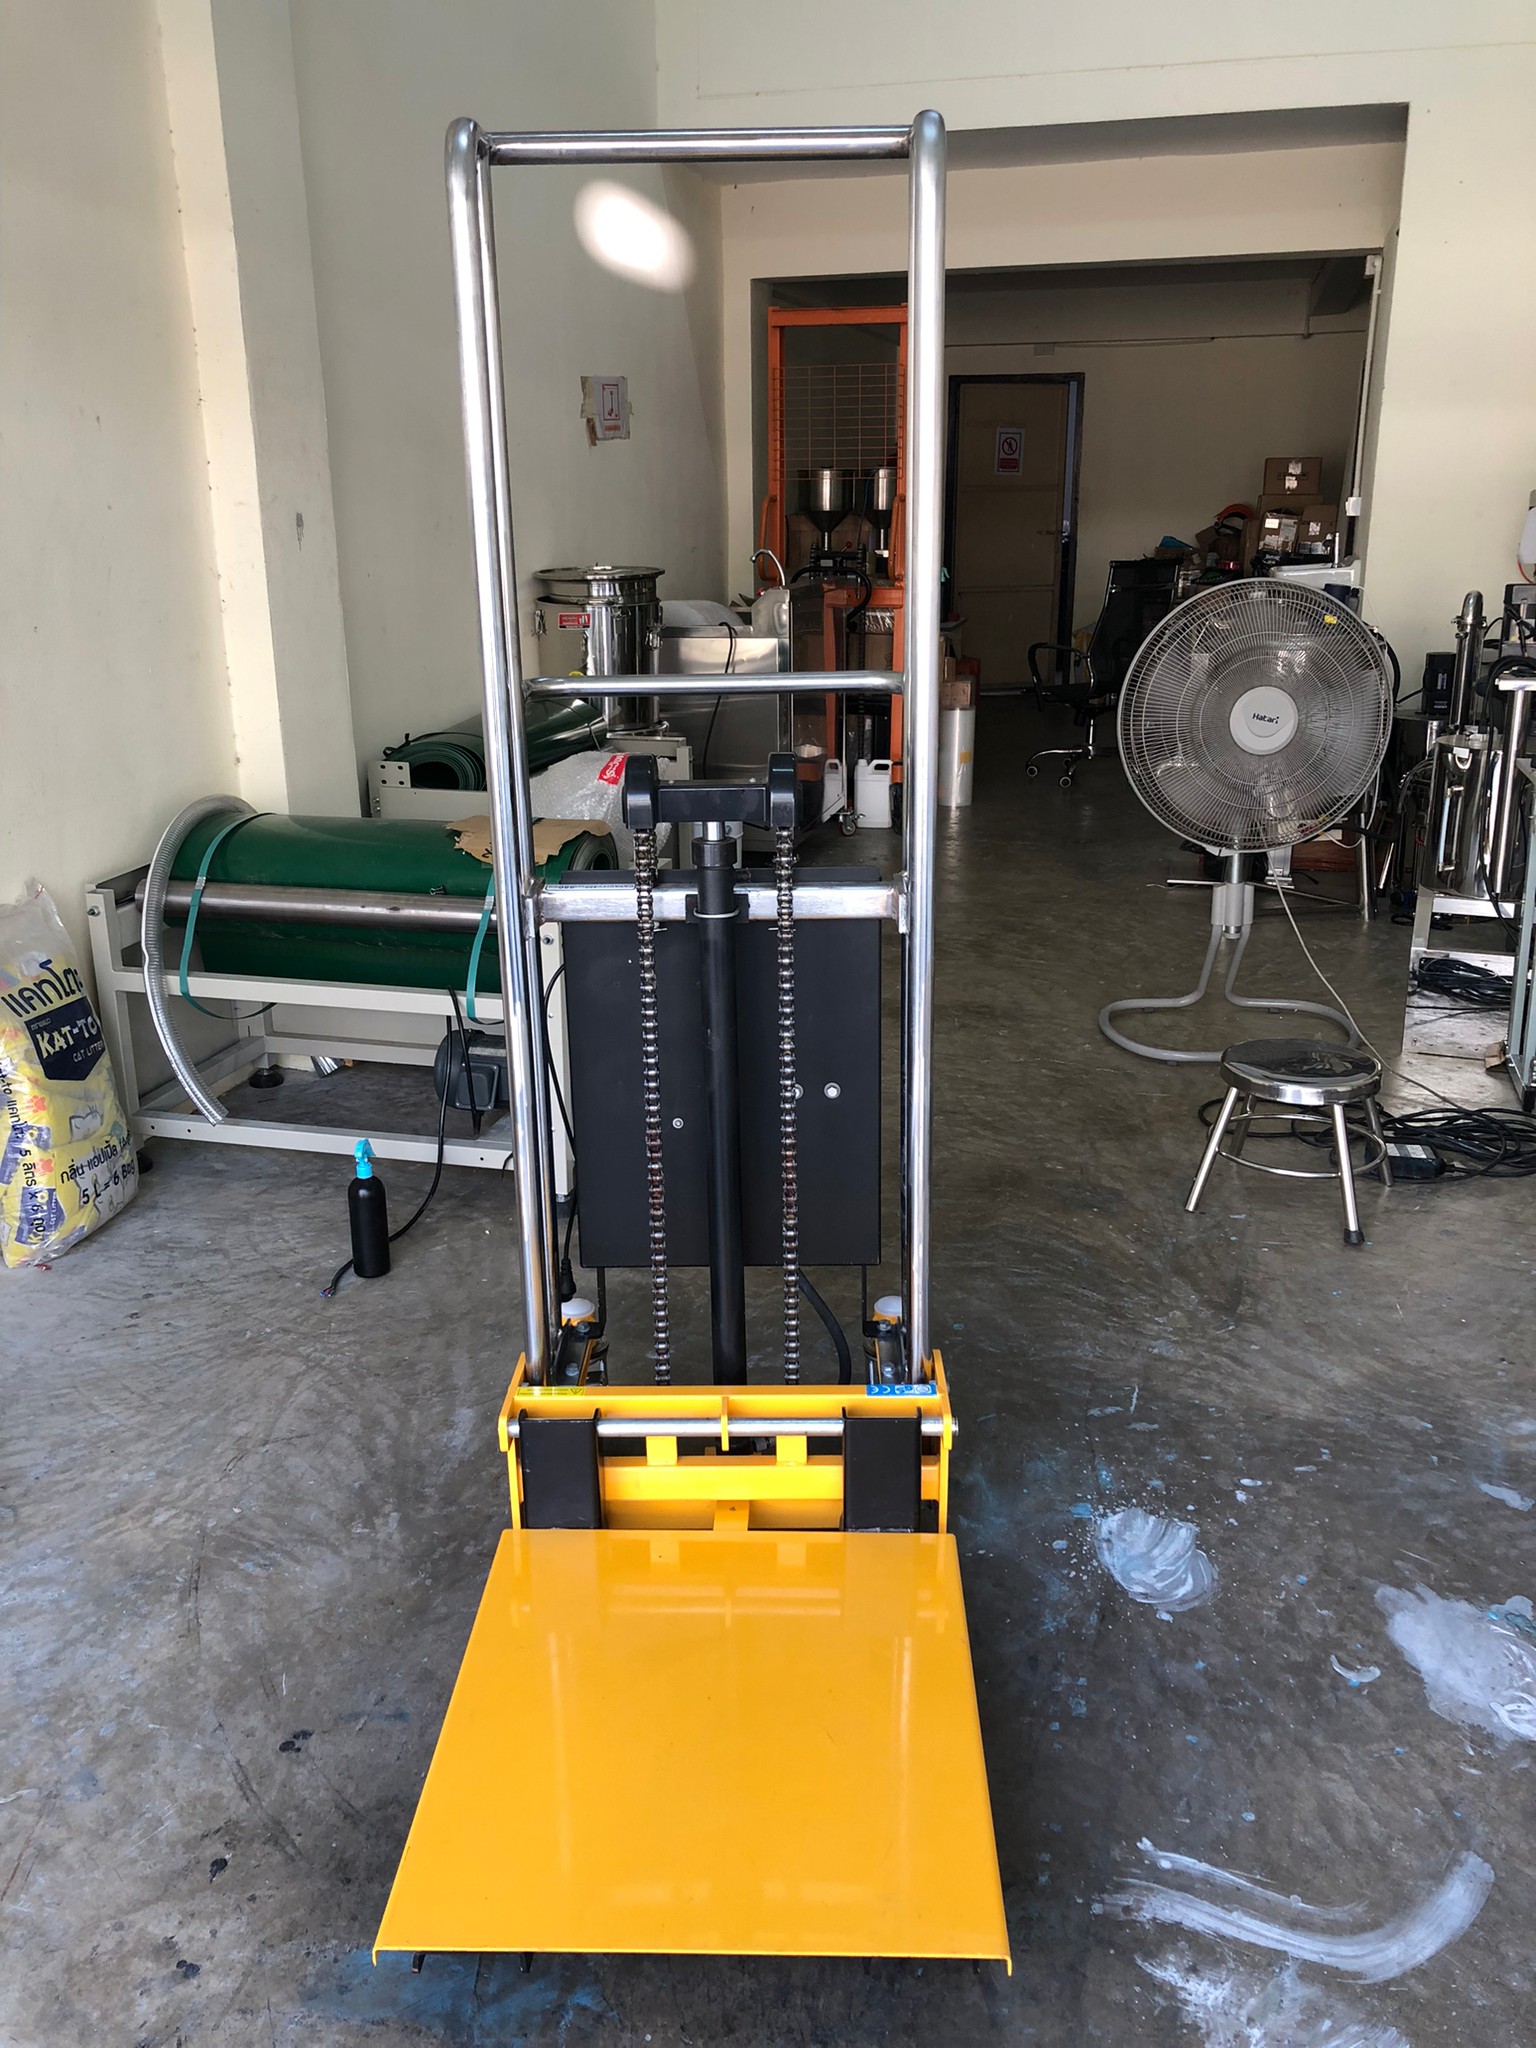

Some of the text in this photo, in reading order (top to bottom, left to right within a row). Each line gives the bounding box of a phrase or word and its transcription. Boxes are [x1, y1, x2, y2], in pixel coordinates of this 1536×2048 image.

[1252, 712, 1279, 724] Hatari
[36, 1015, 98, 1059] KAT-TO
[72, 1049, 85, 1062] CAT
[20, 1149, 32, 1158] 5
[22, 1162, 37, 1187] ลิตร
[60, 1158, 85, 1184] กลิ่น
[82, 1188, 90, 1205] 5
[93, 1183, 101, 1199] L
[113, 1170, 120, 1186] 6
